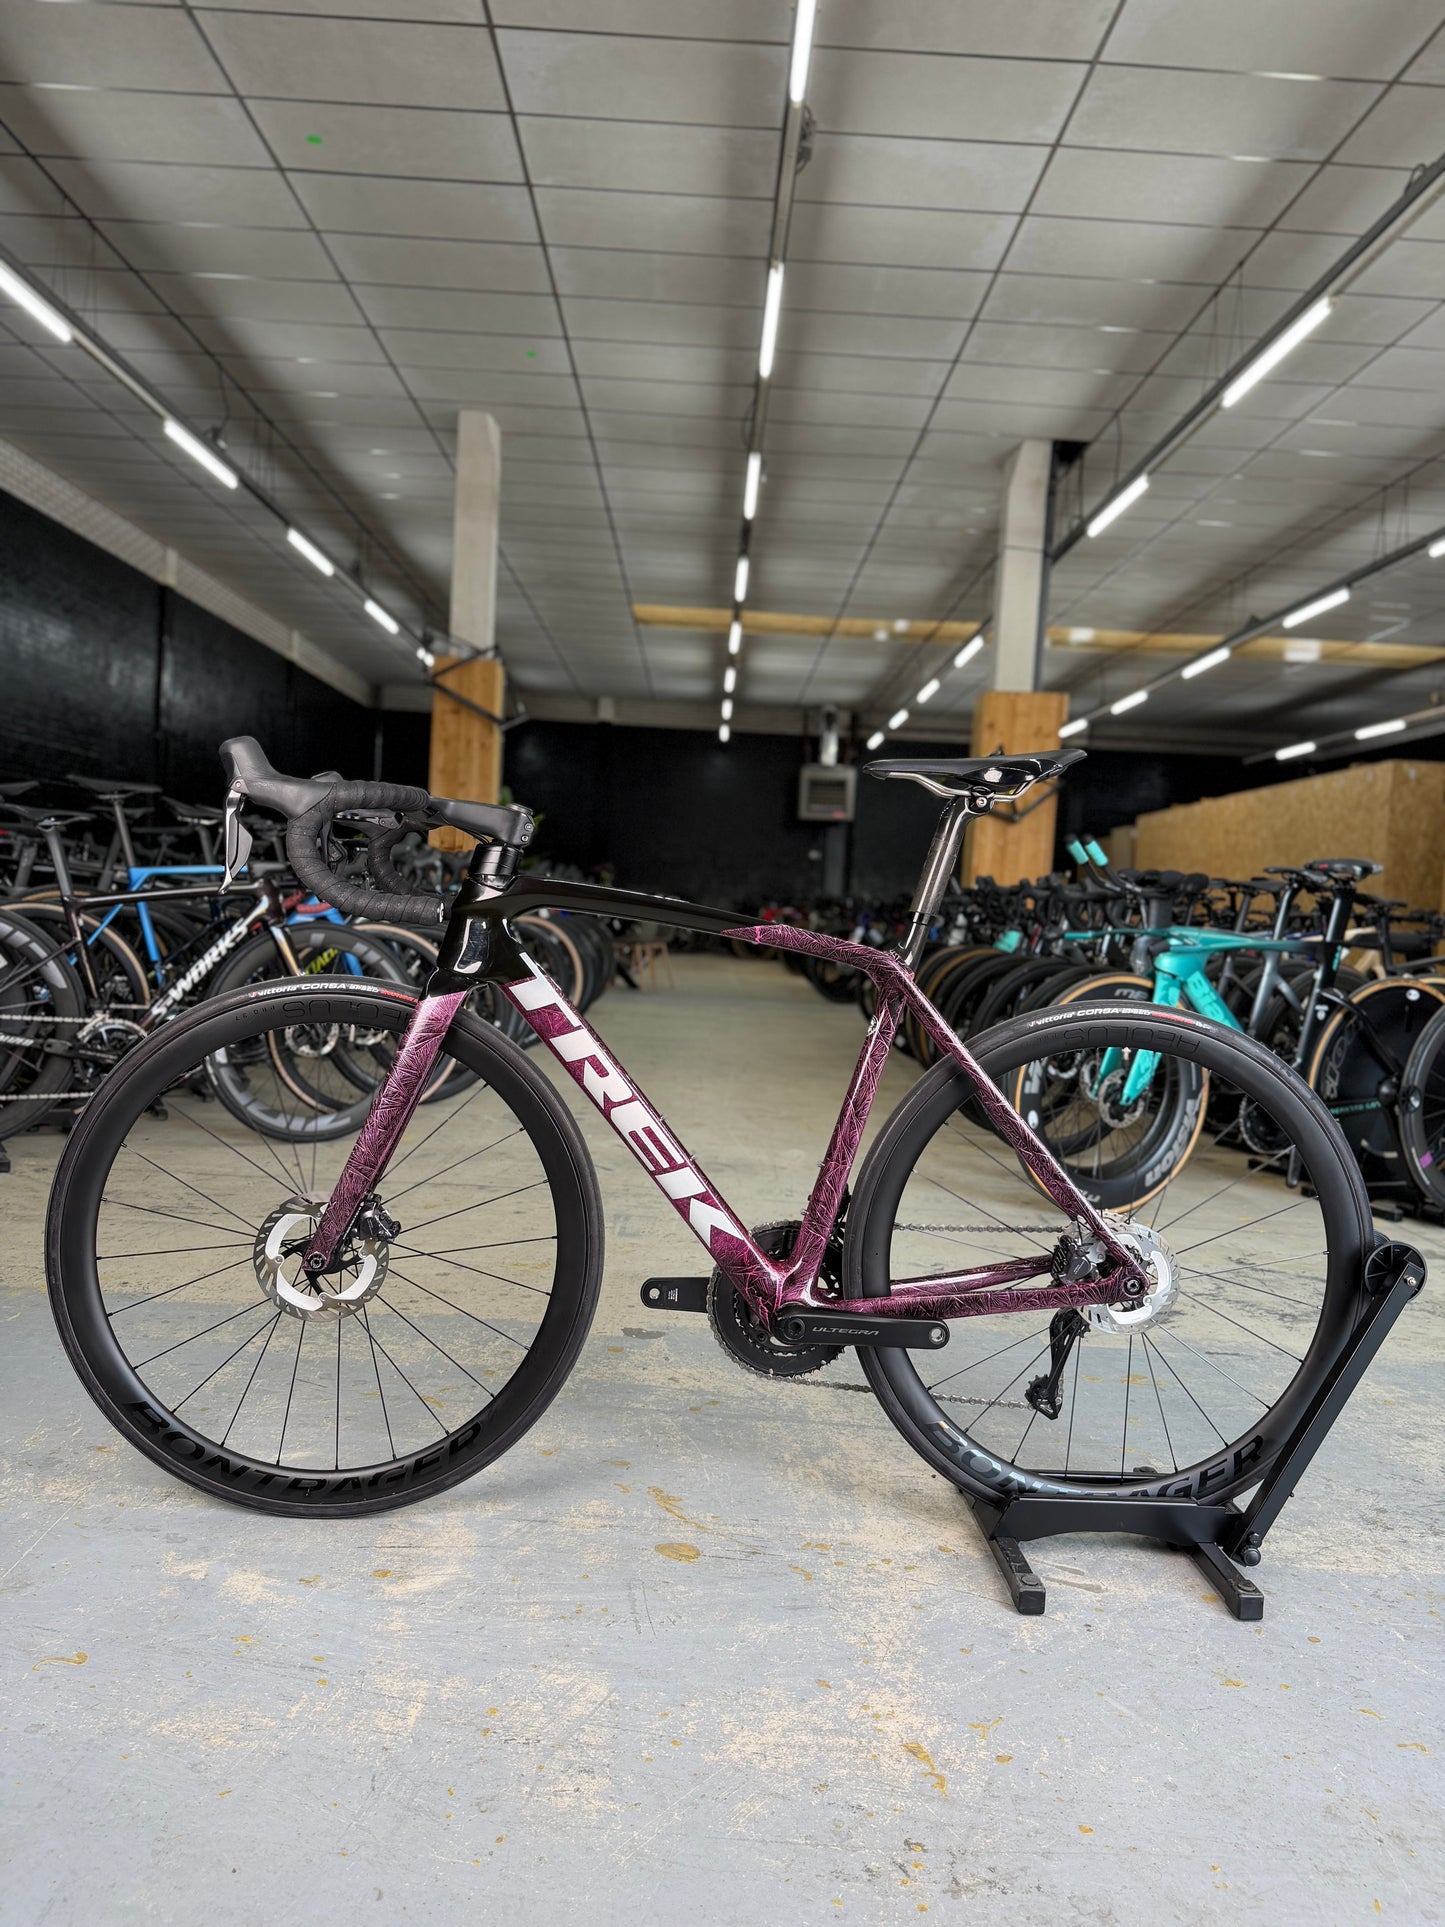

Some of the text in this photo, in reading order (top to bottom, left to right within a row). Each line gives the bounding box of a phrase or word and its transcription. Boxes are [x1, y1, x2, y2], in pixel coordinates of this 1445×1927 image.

[151, 917, 249, 1024] S-WORKS
[301, 982, 346, 991] CORSA
[283, 999, 409, 1024] EOLUS
[1076, 1007, 1120, 1017] CORSA
[1063, 1026, 1201, 1053] AEOLUS
[508, 952, 745, 1248] TREK
[812, 1325, 880, 1337] ULTEGRA
[123, 1401, 483, 1499] BONTRAGER
[924, 1419, 1263, 1498] BONGER
